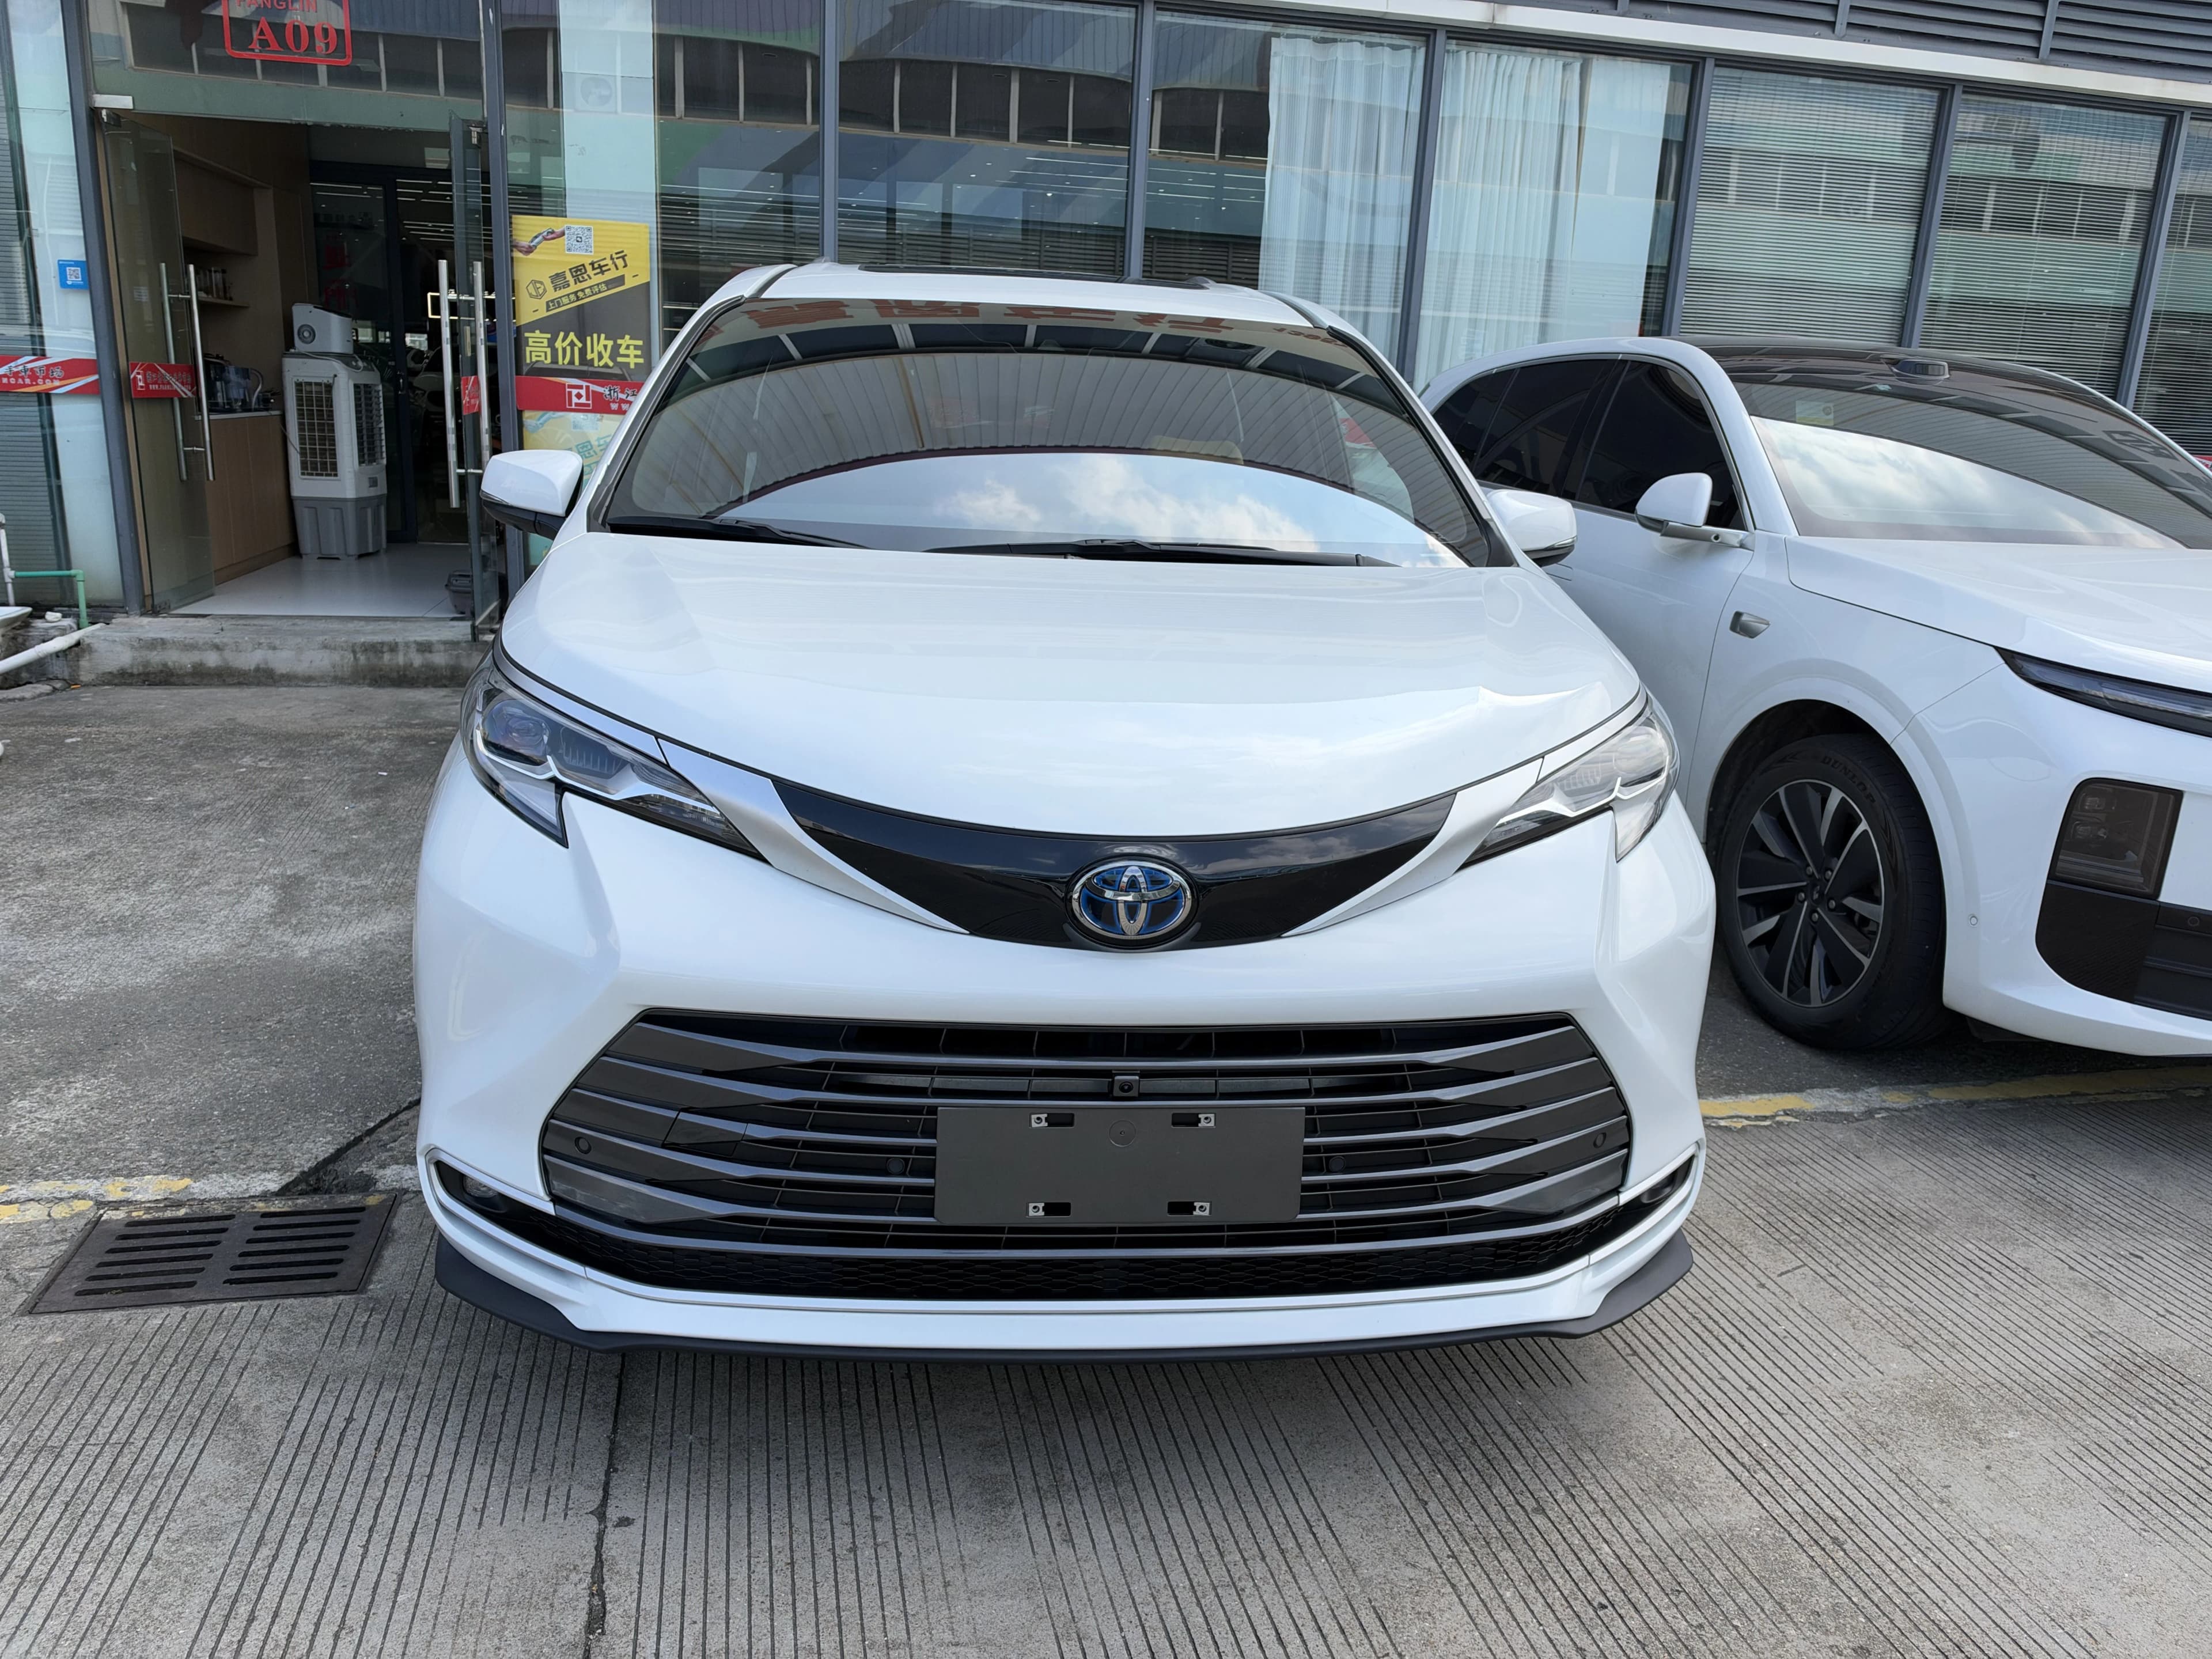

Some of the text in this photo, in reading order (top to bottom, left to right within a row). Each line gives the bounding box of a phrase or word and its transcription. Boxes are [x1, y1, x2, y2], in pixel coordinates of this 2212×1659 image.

[248, 17, 338, 55] A09
[548, 249, 628, 293] 嘉恩车行
[548, 283, 608, 310] 上门服务 免费评估
[524, 329, 645, 369] 高价收车
[603, 385, 638, 401] 浙江
[1820, 756, 1876, 803] DUNLOP
